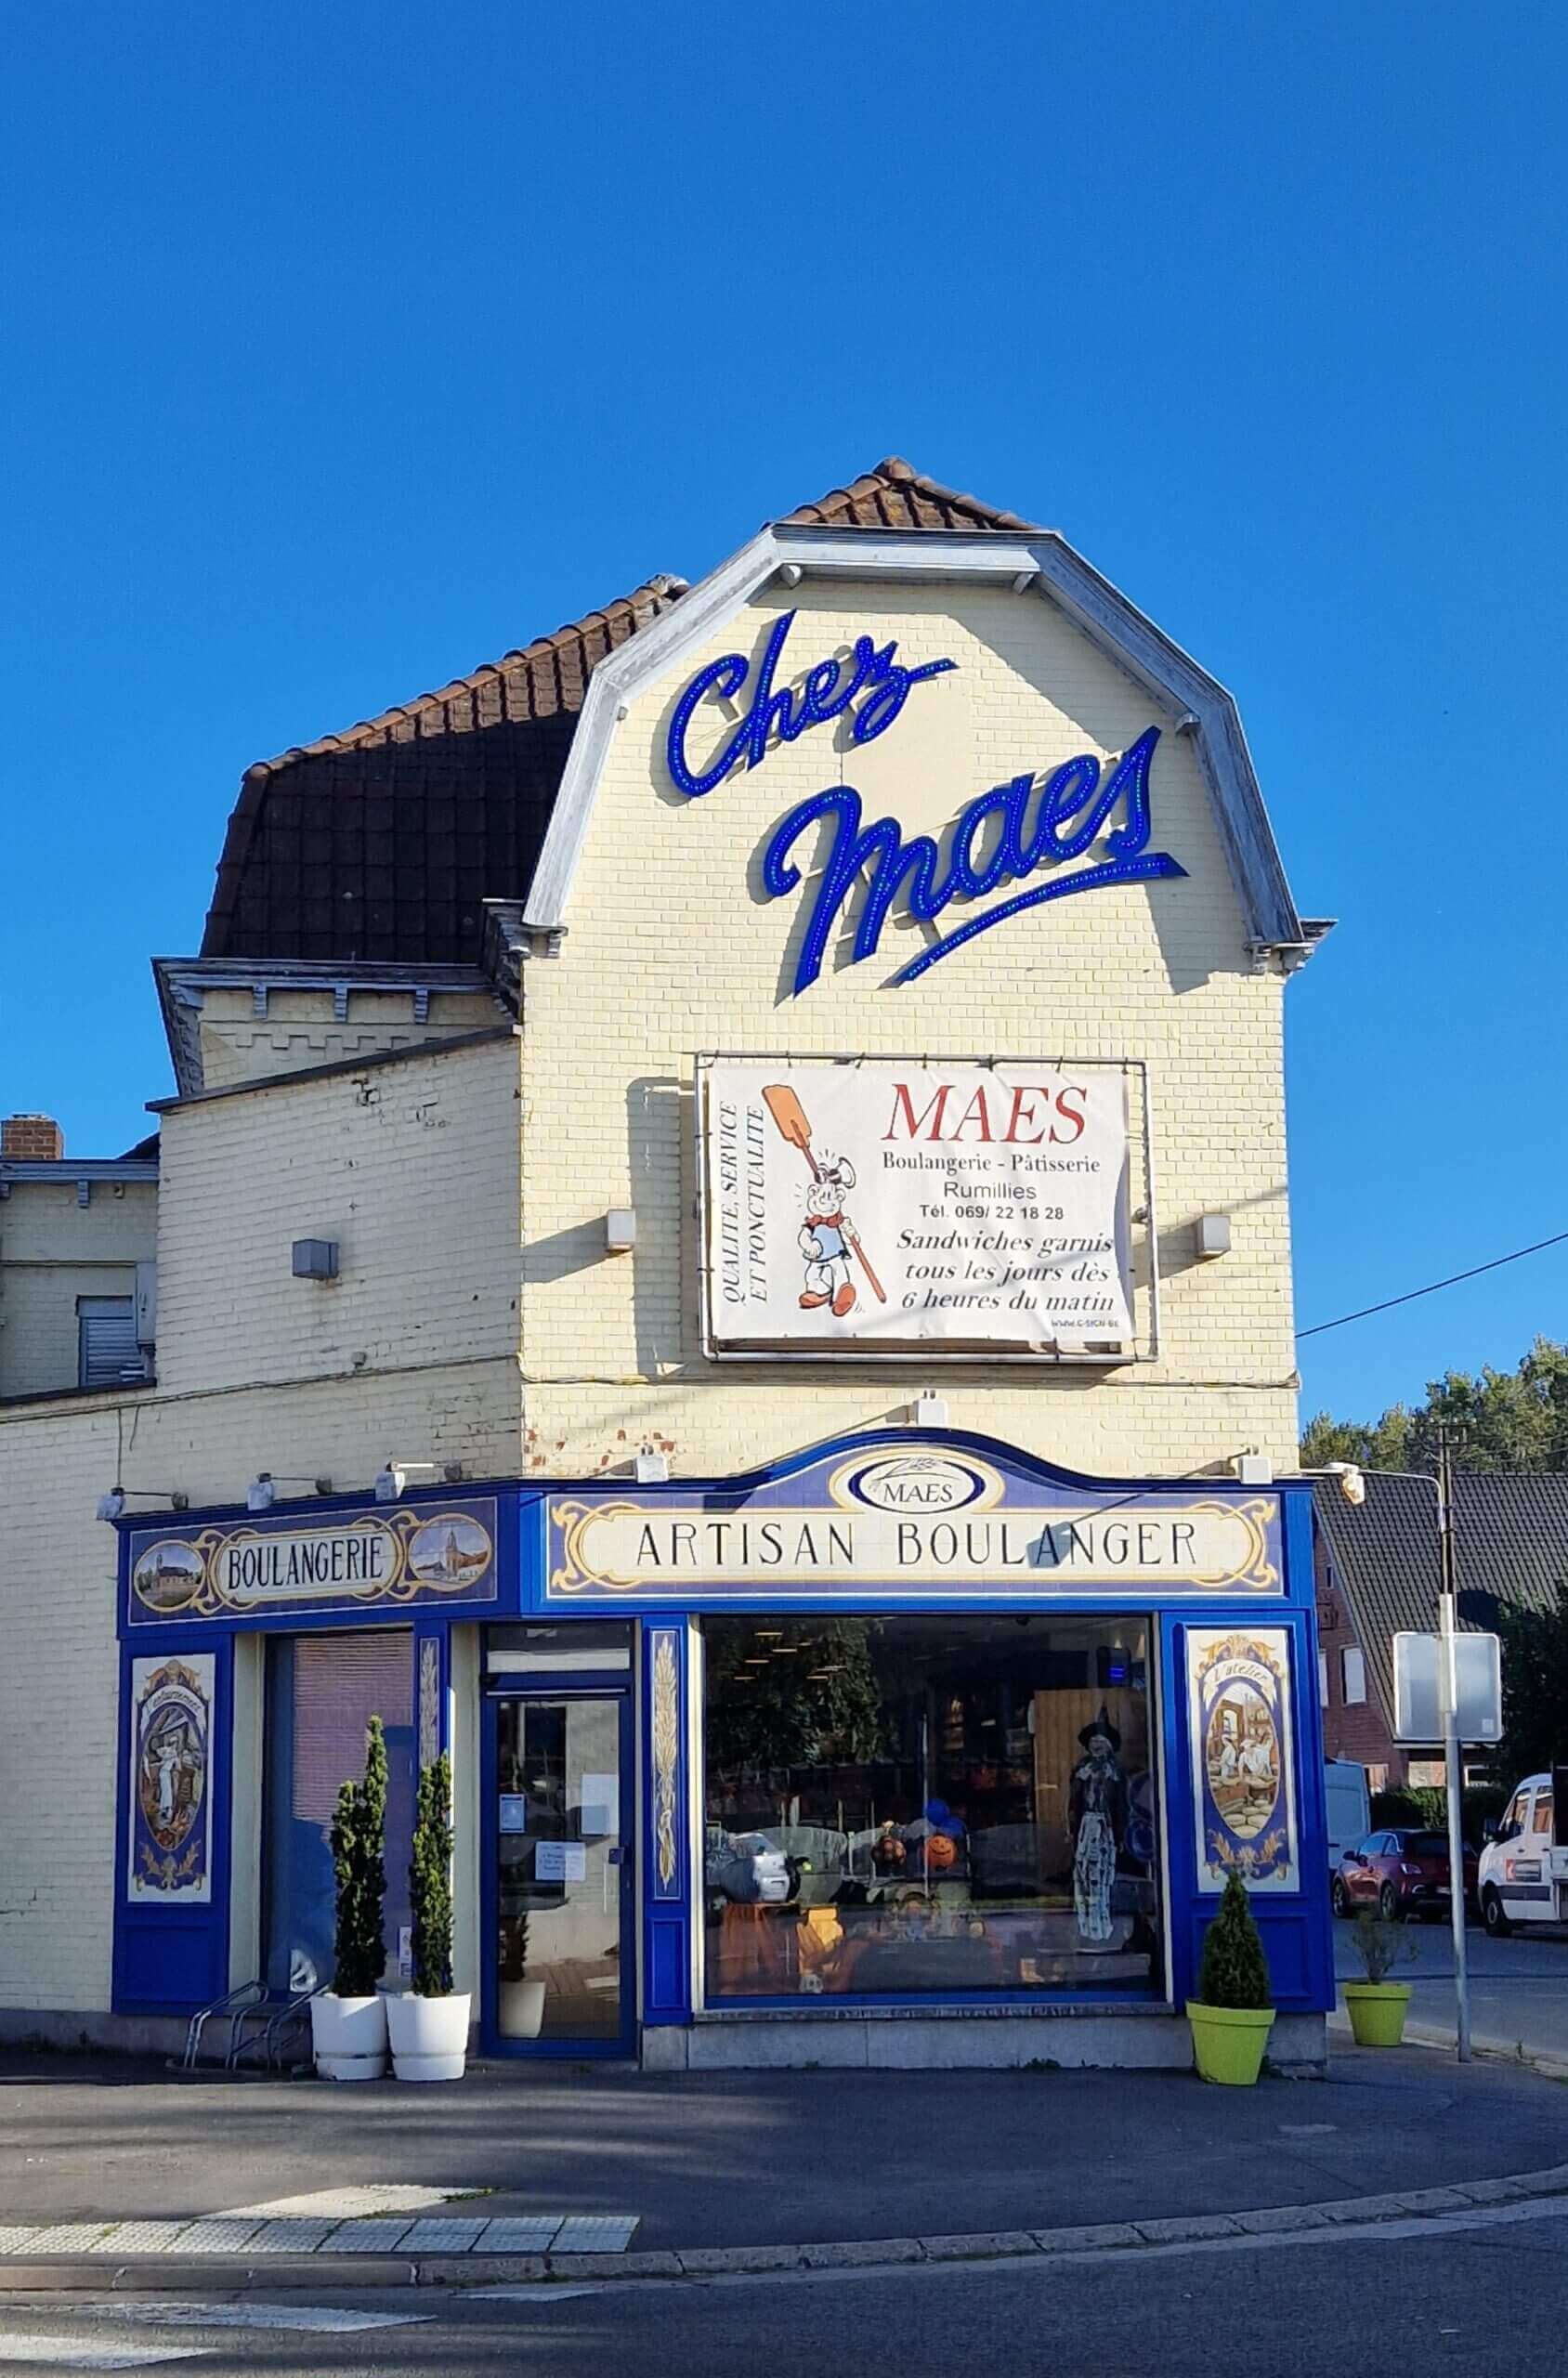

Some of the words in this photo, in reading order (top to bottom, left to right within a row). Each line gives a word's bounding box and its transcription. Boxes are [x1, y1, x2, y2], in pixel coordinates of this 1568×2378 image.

[667, 608, 959, 797] Chez
[764, 725, 1172, 999] Maes
[881, 1084, 1087, 1144] MAES
[720, 1101, 738, 1195] SERVICE
[882, 1152, 991, 1176] Boulangerie
[1012, 1154, 1100, 1173] Pâtisserie
[747, 1105, 765, 1265] PONCTUALITE
[944, 1182, 1037, 1199] Rumillies
[920, 1205, 949, 1219] Tél.
[955, 1206, 989, 1219] 069/
[996, 1207, 1013, 1219] 22
[1022, 1207, 1039, 1219] 18
[1045, 1208, 1064, 1220] 28
[721, 1202, 746, 1305] QUALITE,
[896, 1228, 1034, 1251] Sandwiches
[1038, 1233, 1114, 1258] garnis
[750, 1270, 766, 1302] ET
[905, 1262, 957, 1279] tous
[963, 1261, 996, 1280] les
[997, 1261, 1064, 1287] jours
[1071, 1261, 1109, 1282] dès
[902, 1291, 918, 1309] 6
[923, 1288, 1001, 1310] heures
[1009, 1289, 1038, 1310] du
[1045, 1291, 1114, 1311] matin
[883, 1483, 953, 1503] MAES
[637, 1522, 854, 1565] ARTISAN
[897, 1522, 1196, 1565] BOULANGER
[229, 1536, 384, 1590] BOULANGERIE
